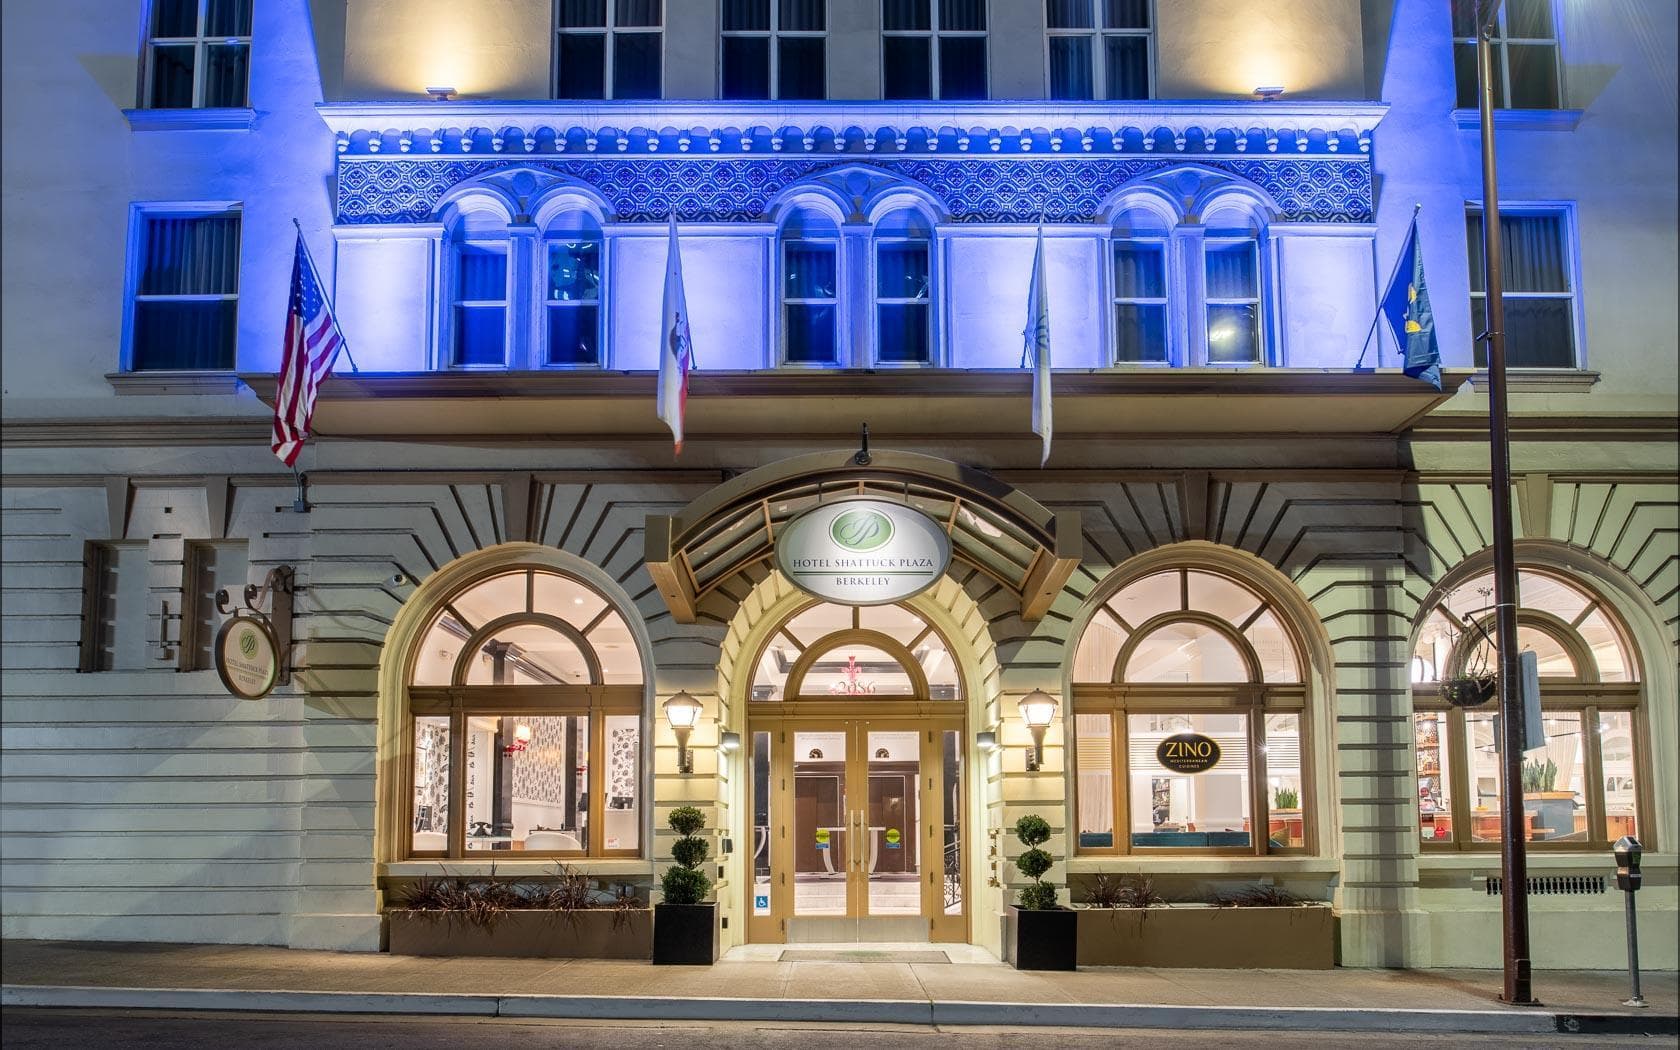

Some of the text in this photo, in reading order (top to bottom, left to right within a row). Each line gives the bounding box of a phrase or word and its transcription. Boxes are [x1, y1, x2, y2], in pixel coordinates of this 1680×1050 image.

[793, 558, 933, 568] HOTEL SHATTUCK PLAZA
[835, 576, 890, 586] BERKELEY
[1165, 741, 1212, 757] ZINO
